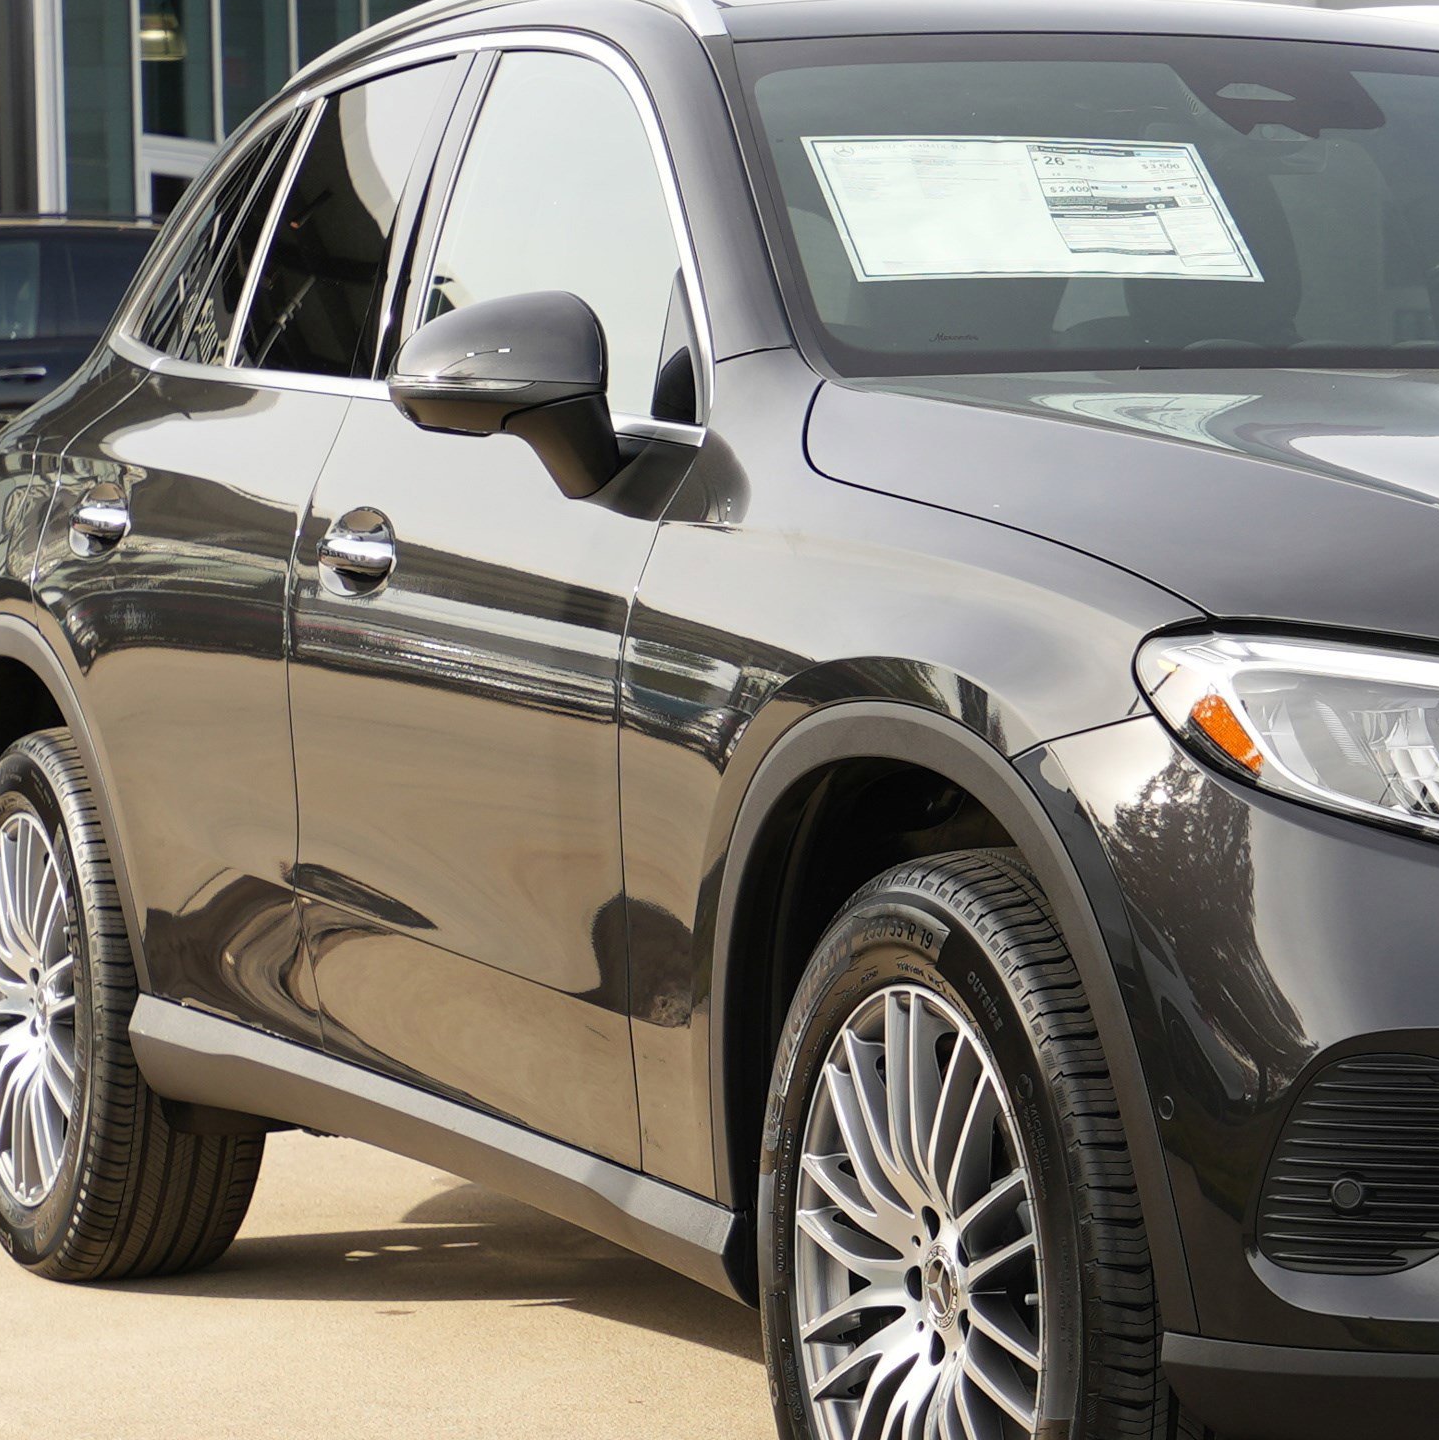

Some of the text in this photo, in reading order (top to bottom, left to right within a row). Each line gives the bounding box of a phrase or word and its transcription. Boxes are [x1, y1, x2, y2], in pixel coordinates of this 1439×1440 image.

[1043, 155, 1065, 166] 26
[906, 922, 917, 942] R
[919, 928, 934, 950] 19
[967, 970, 1004, 1032] OUTSIDE
